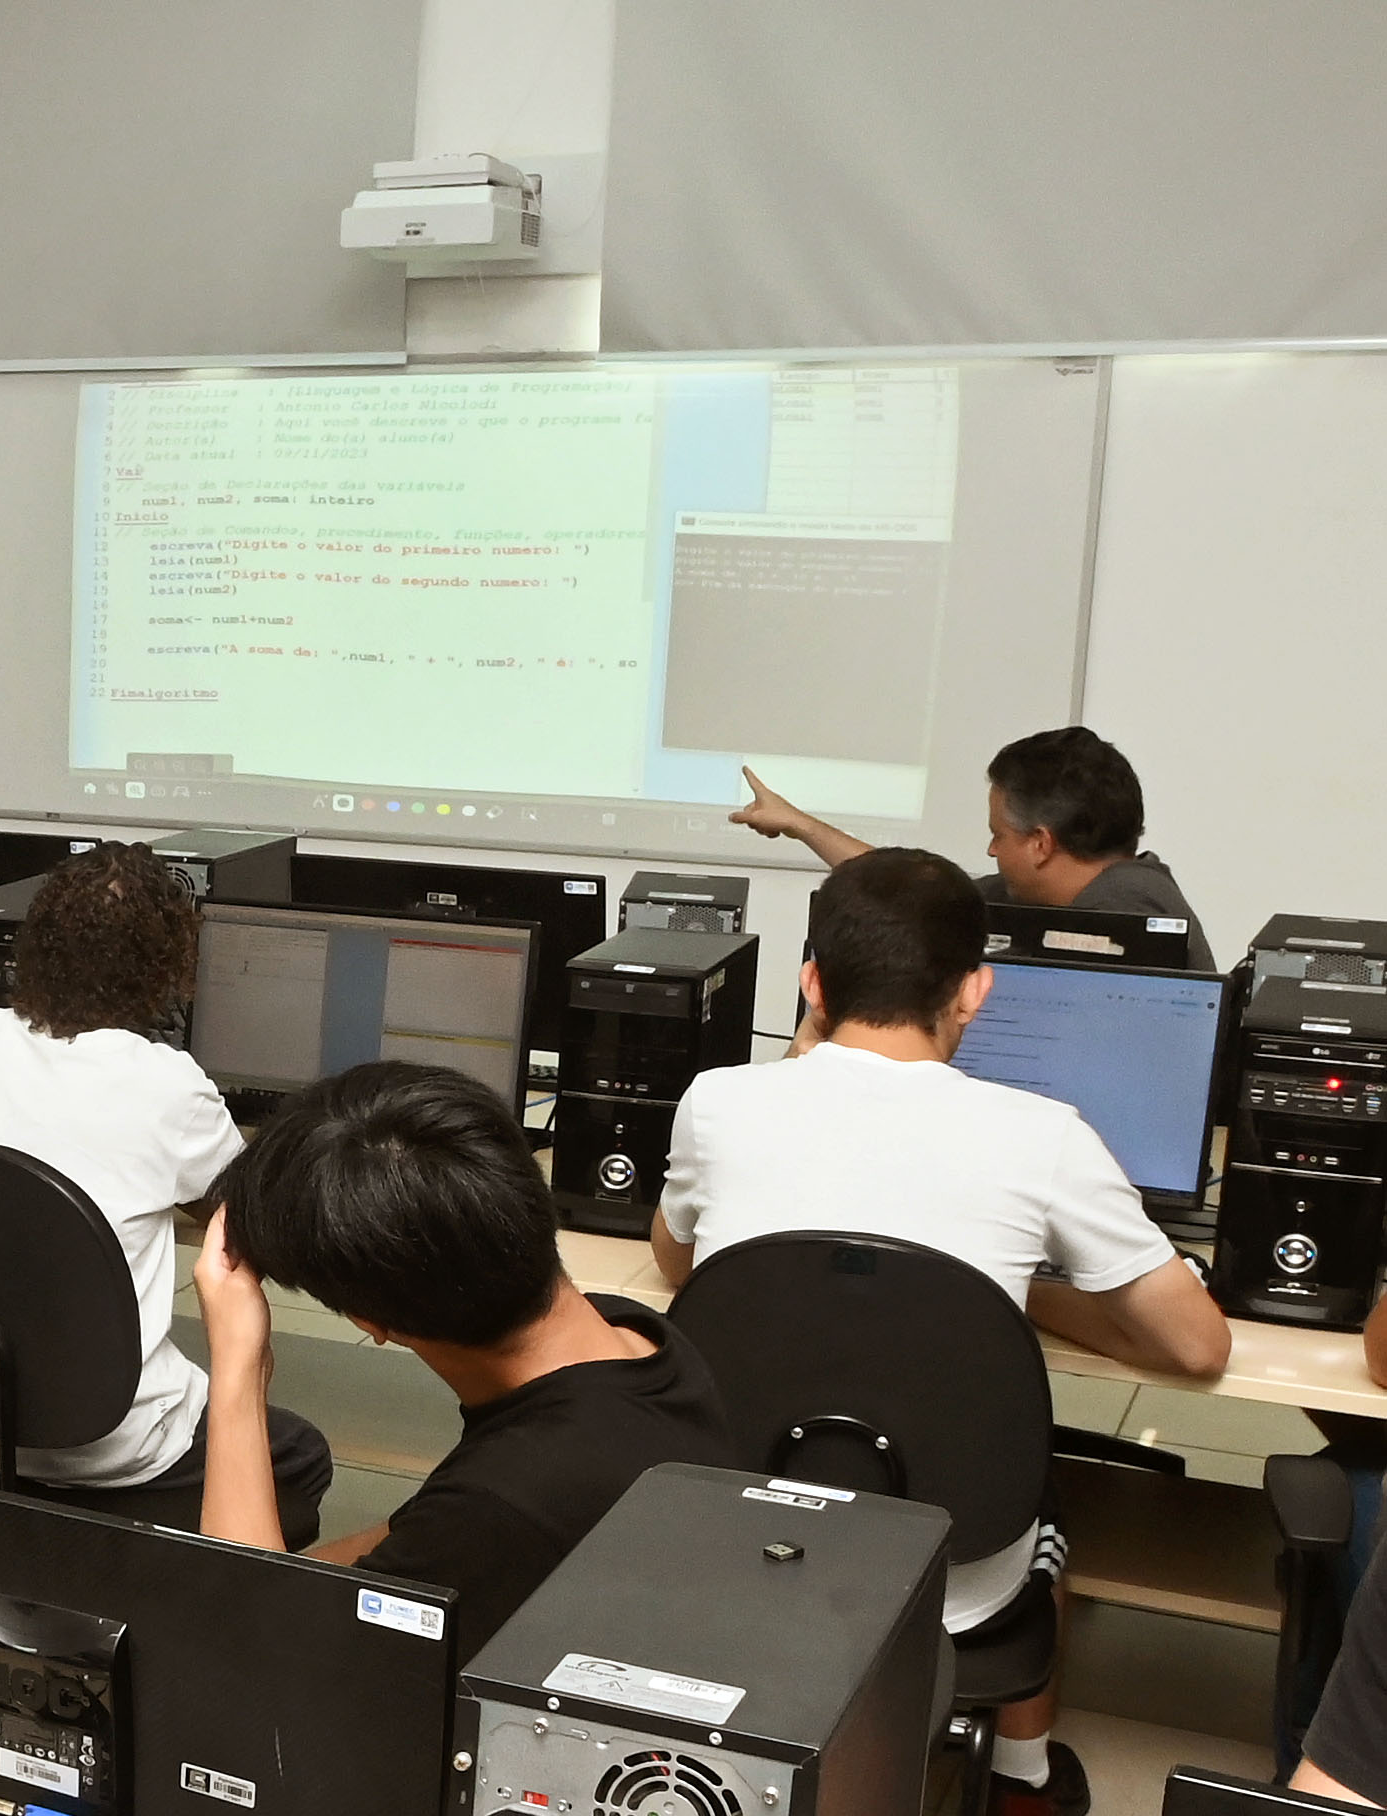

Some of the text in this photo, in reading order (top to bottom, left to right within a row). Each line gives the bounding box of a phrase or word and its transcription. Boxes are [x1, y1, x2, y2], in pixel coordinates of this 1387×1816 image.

[275, 401, 341, 412] Antonio
[349, 400, 410, 411] Carlos
[478, 416, 509, 429] que
[538, 414, 621, 428] programa
[274, 434, 313, 444] Nome
[144, 451, 180, 462] Data
[310, 496, 375, 505] inteiro
[296, 542, 307, 550] o
[316, 542, 364, 552] valor
[373, 544, 391, 553] do
[401, 544, 482, 557] primeiro
[296, 572, 305, 580] o
[315, 571, 363, 582] valor
[373, 575, 391, 585] do
[401, 576, 469, 588] segundo
[213, 615, 294, 625] num1+num2
[248, 645, 283, 655] soma
